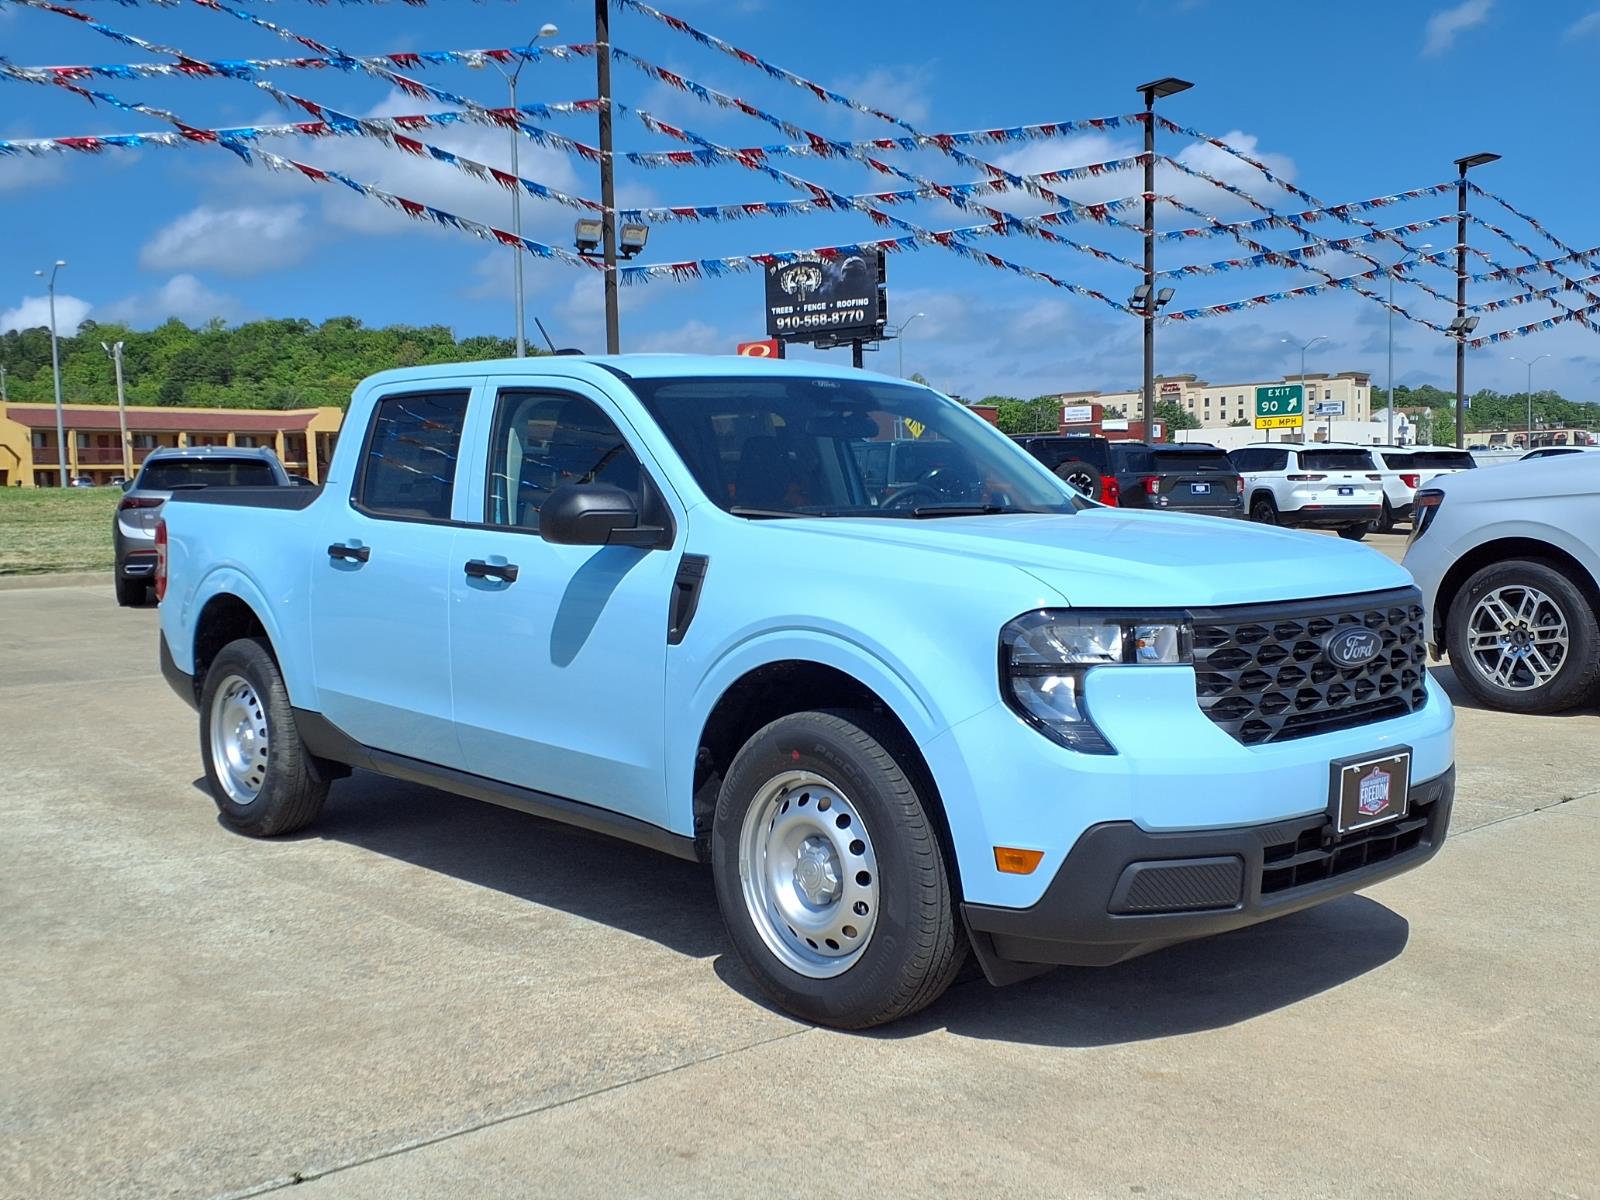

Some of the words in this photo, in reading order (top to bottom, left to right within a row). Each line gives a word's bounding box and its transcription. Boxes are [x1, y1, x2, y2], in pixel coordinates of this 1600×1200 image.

[771, 306, 794, 315] TREES
[803, 302, 827, 312] FENCE
[836, 297, 869, 308] ROOFING
[776, 309, 865, 330] 910-568-8770
[1268, 388, 1290, 397] EXIT
[1261, 400, 1279, 412] 90
[1262, 419, 1273, 427] 30
[1279, 418, 1297, 426] MPH
[1343, 635, 1374, 660] Ford
[1360, 783, 1389, 807] FREEDOM
